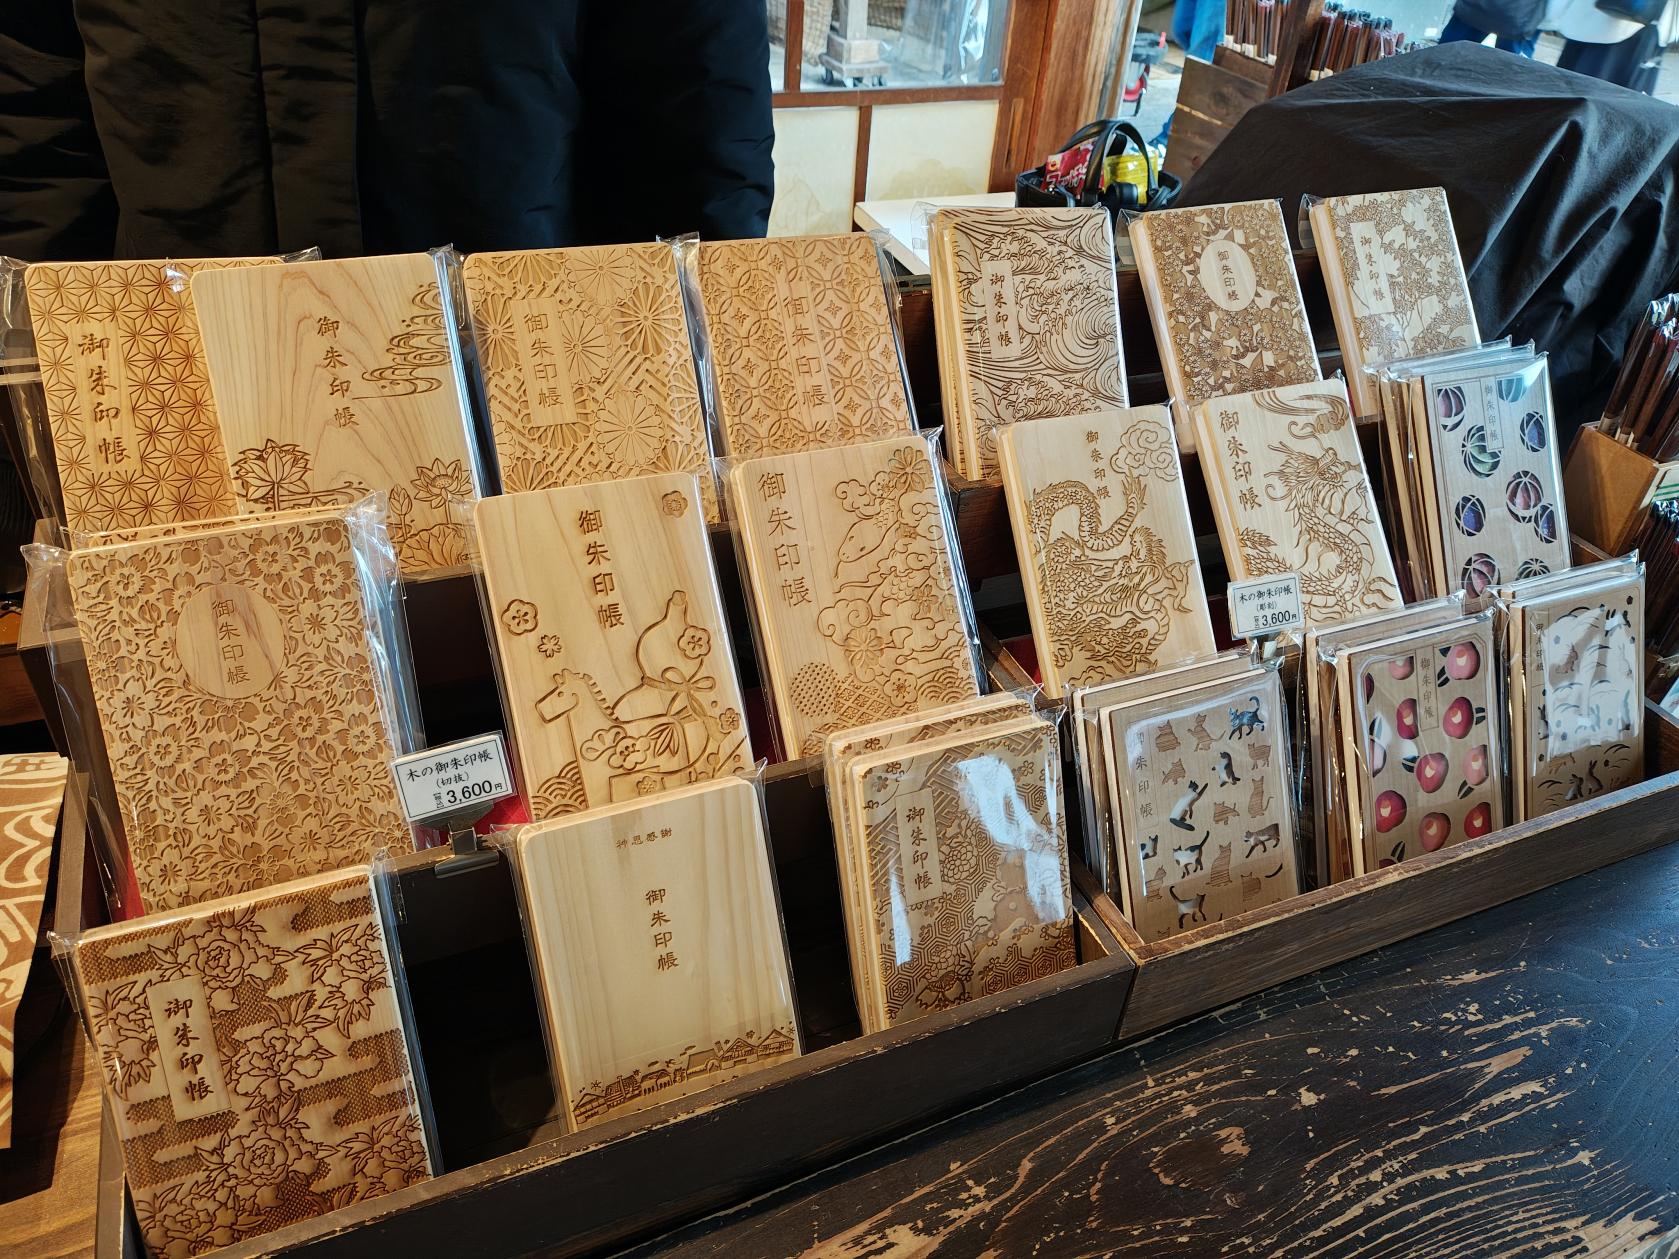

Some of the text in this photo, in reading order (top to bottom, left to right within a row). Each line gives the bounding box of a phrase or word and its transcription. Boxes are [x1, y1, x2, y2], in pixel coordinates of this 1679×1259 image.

[1218, 250, 1239, 301] 御朱印帳
[1360, 237, 1385, 299] 御朱印帳
[783, 296, 829, 405] 御朱印帳
[990, 273, 1013, 346] 御朱印帳
[78, 333, 131, 465] 御朱印帳
[317, 316, 359, 428] 御朱印帳
[524, 312, 564, 408] 御朱印帳
[1086, 431, 1111, 499] 御朱印帳
[1219, 410, 1259, 511] 御朱印帳
[574, 509, 624, 628] 御朱印帳
[758, 472, 811, 607] 御朱印帳
[1239, 584, 1292, 602] 木の御朱印帳
[1262, 610, 1297, 626] 3,600円
[212, 599, 250, 685] 御朱印帳
[407, 749, 493, 781] 木の御朱印帳
[447, 780, 502, 805] 3,600円
[906, 808, 933, 890] 御朱印帳
[646, 889, 679, 970] 御朱印帳
[165, 998, 214, 1101] 御朱印帳
